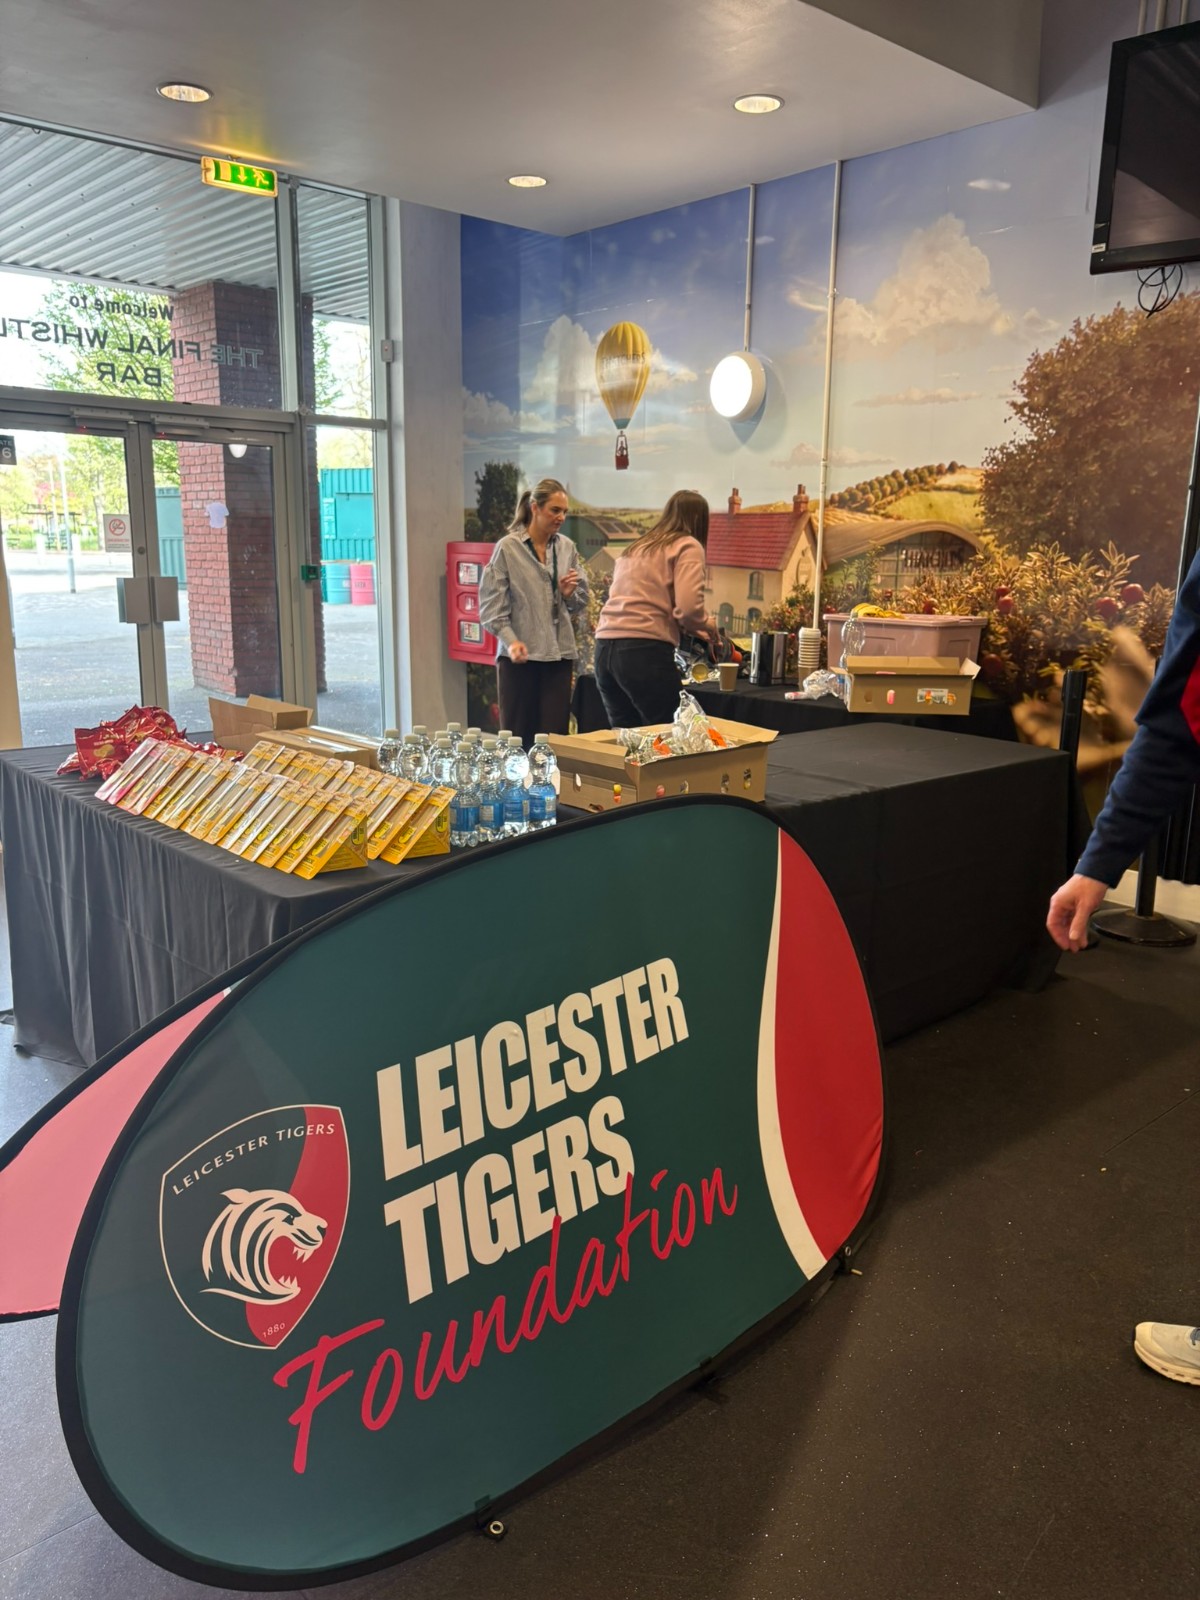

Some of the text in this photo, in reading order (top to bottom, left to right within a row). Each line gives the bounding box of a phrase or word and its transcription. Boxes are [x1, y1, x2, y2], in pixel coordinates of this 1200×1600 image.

[2, 447, 12, 459] 6
[376, 957, 690, 1182] LEICESTER
[172, 1123, 336, 1196] LEICESTER TIGERS
[383, 1095, 636, 1305] TIGERS
[262, 1321, 286, 1339] 1880
[272, 1167, 738, 1474] Foundation
